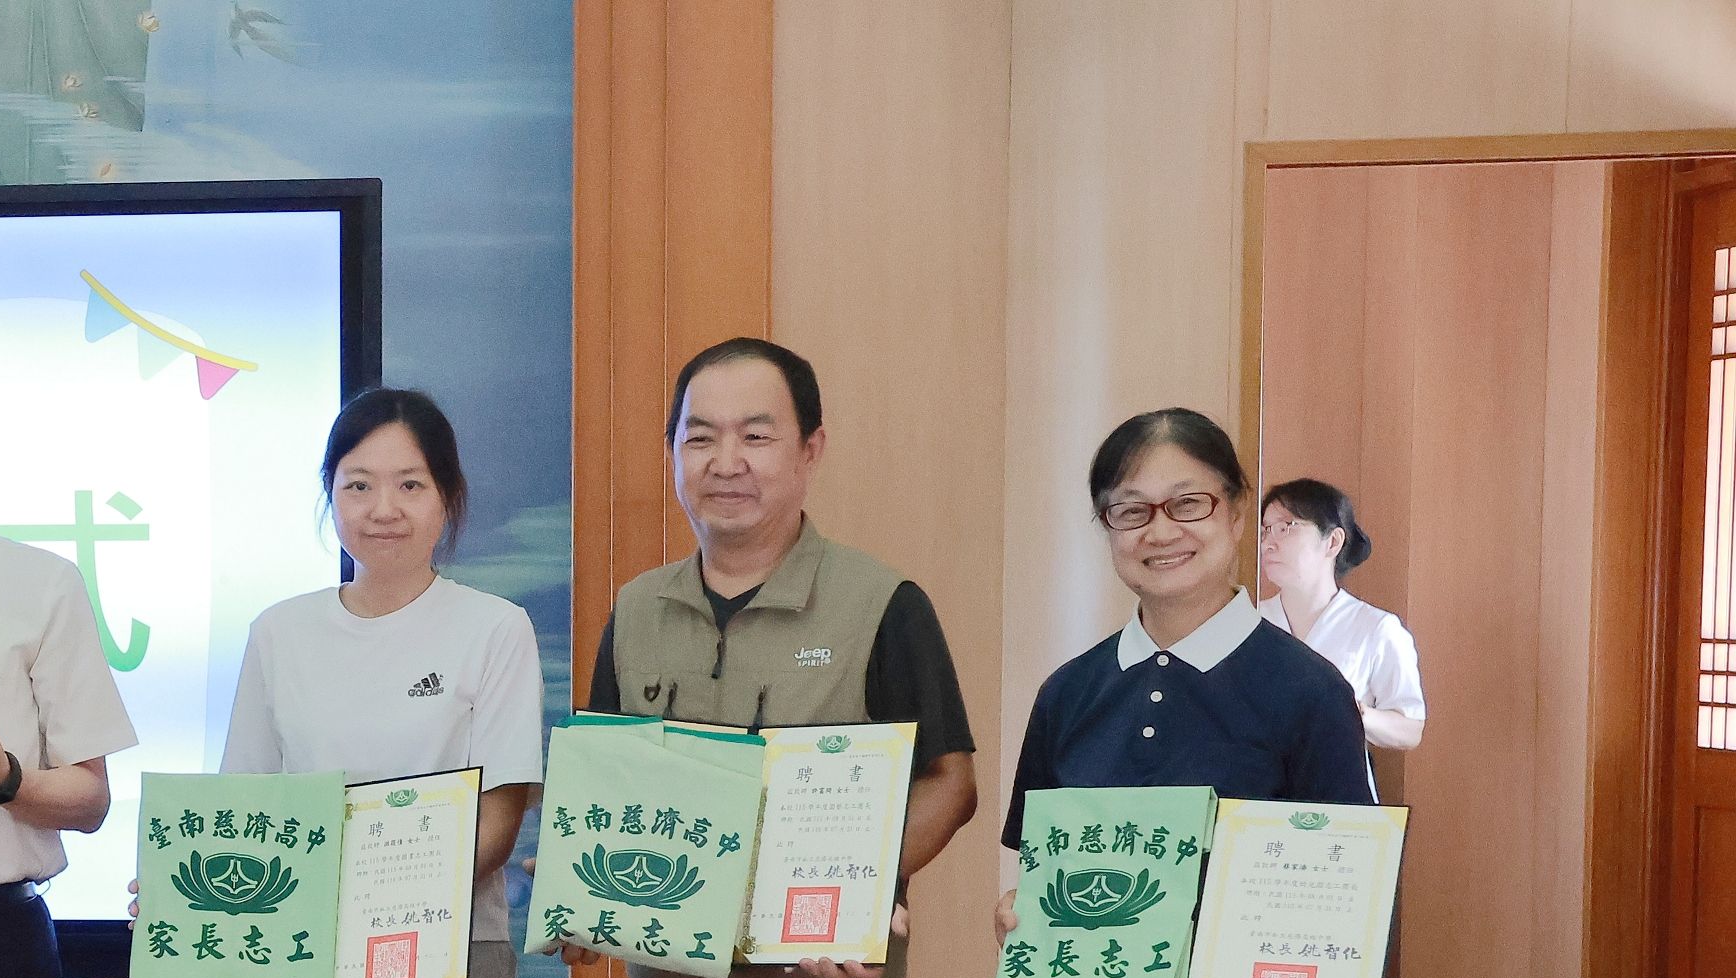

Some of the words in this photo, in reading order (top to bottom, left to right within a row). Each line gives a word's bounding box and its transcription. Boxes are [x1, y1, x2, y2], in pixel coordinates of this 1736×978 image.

[794, 647, 832, 660] Jeep
[795, 764, 864, 784] 聘書
[148, 809, 326, 854] 臺南慈濟高中
[368, 814, 432, 838] 聘書
[553, 804, 741, 858] 臺南慈濟高中
[1019, 822, 1198, 873] 臺南慈濟高中
[1264, 840, 1345, 862] 聘書
[147, 920, 314, 965] 家長志工
[543, 904, 716, 961] 家長志工
[1004, 938, 1173, 978] 家長志工
